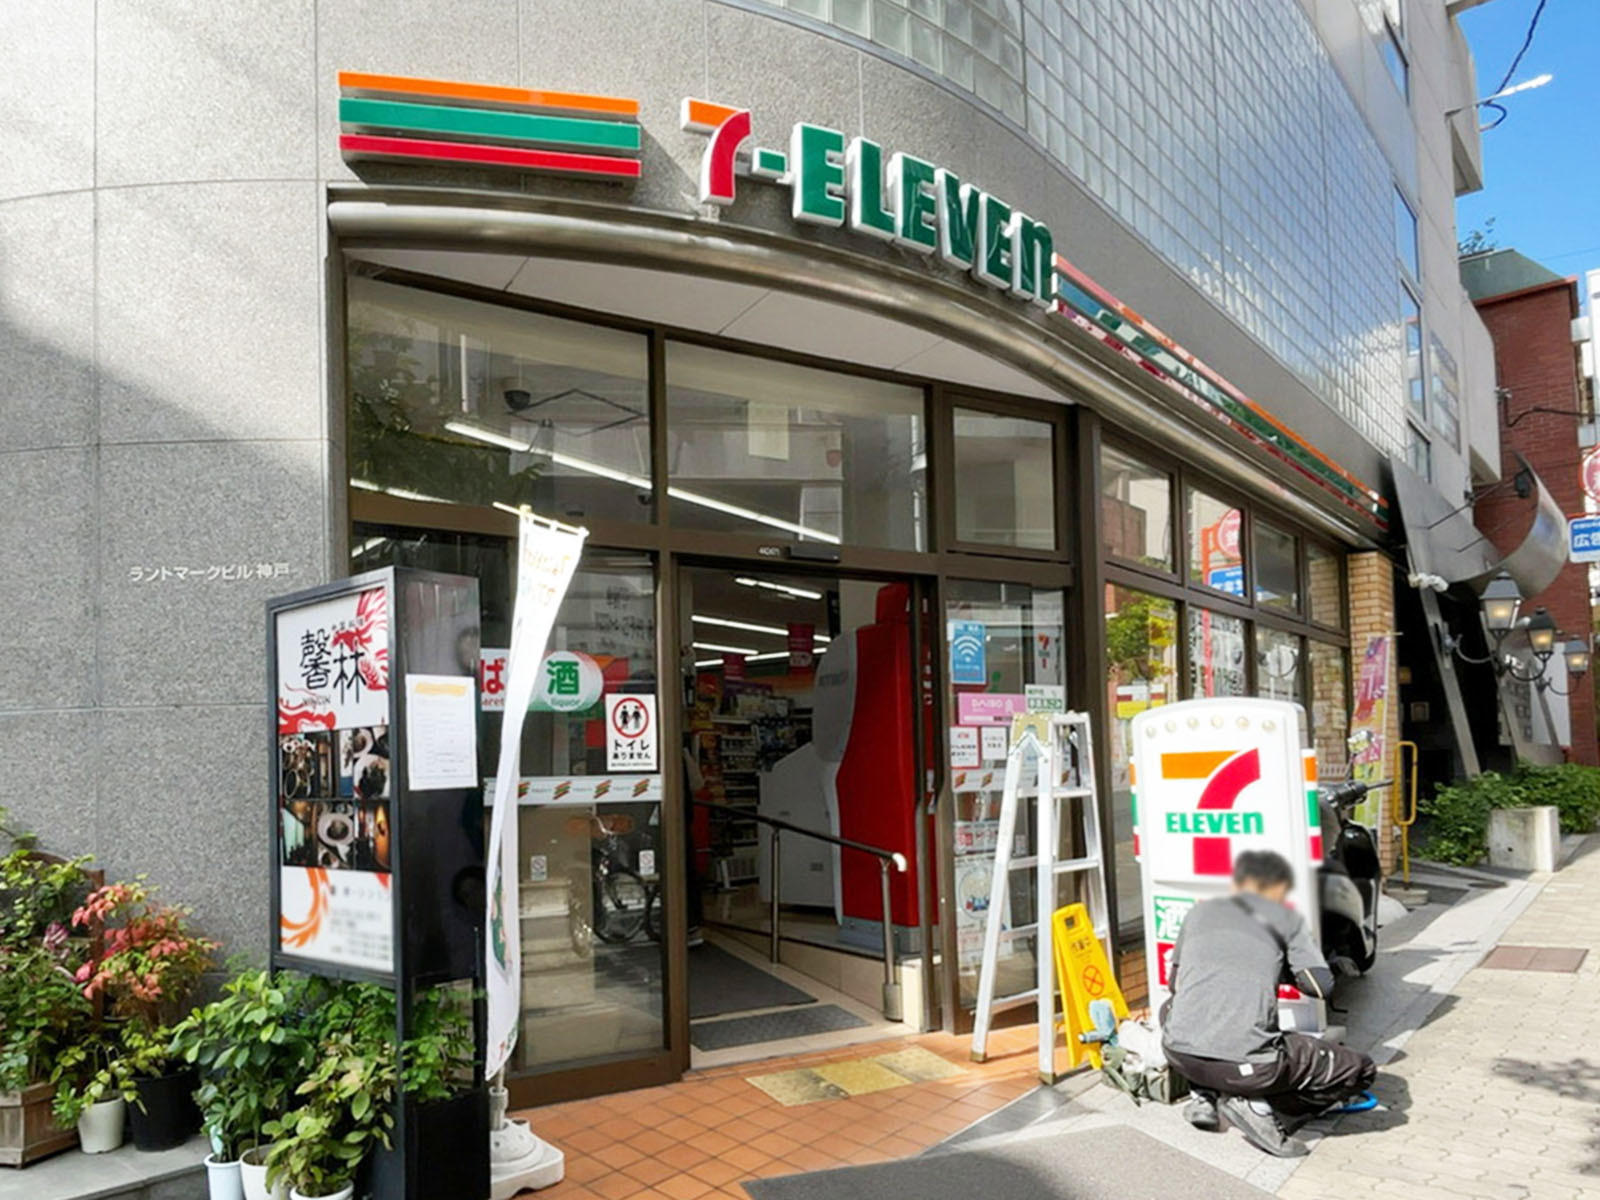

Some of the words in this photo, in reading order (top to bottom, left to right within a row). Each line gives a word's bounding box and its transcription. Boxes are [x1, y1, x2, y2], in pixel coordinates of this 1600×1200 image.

[547, 659, 580, 695] 酒
[614, 739, 650, 751] トイレ
[612, 752, 652, 761] ありません
